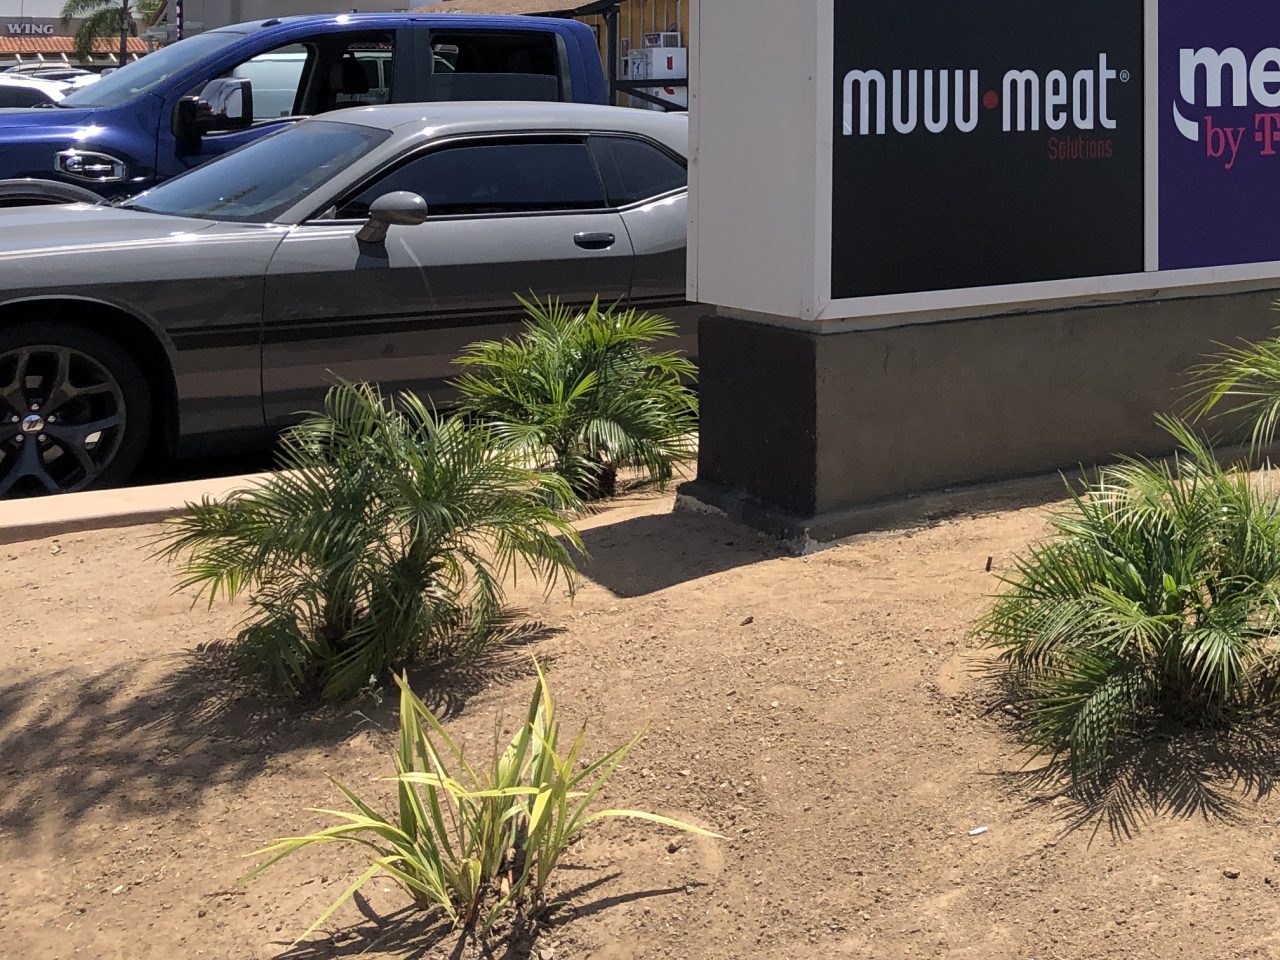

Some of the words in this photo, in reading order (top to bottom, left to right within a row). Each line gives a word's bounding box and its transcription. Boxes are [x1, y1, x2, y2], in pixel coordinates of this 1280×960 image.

[7, 23, 54, 34] WING
[843, 69, 979, 136] muuu
[1002, 53, 1117, 132] meat
[1048, 136, 1113, 160] Solutions
[1205, 116, 1246, 169] by
